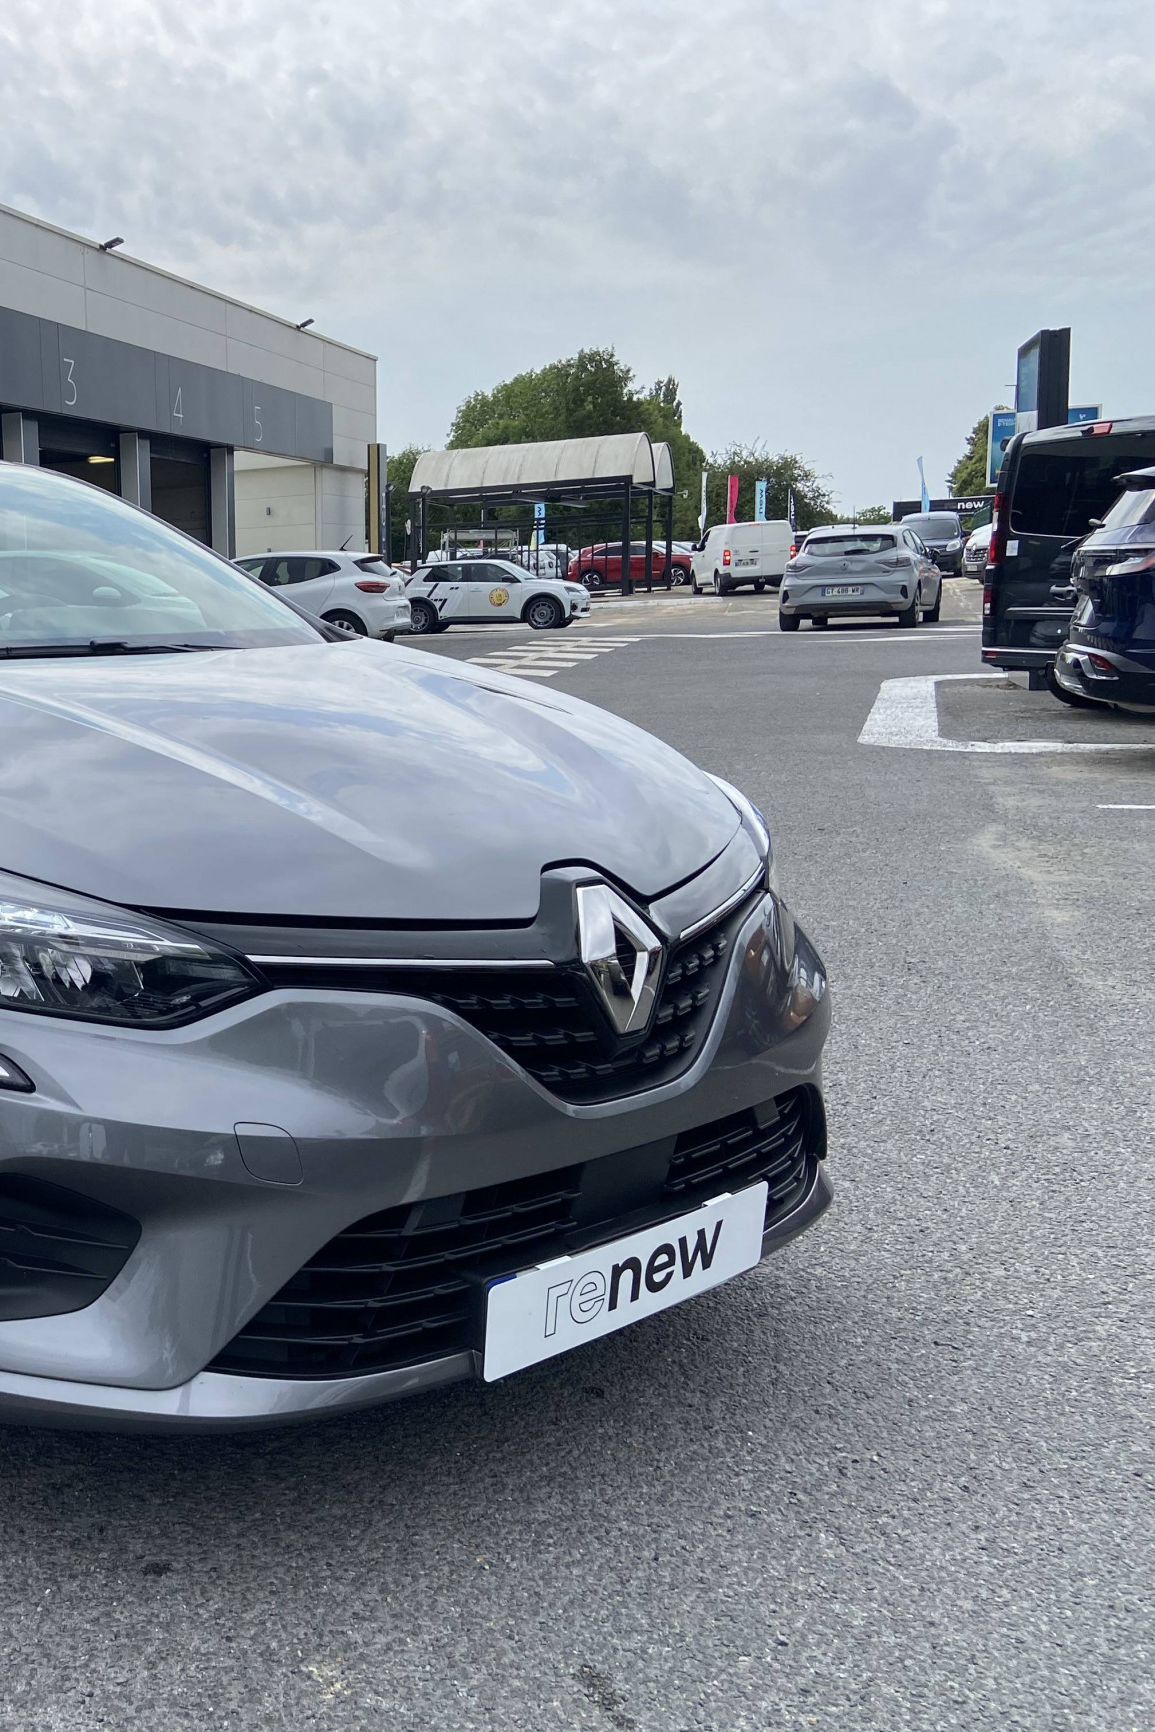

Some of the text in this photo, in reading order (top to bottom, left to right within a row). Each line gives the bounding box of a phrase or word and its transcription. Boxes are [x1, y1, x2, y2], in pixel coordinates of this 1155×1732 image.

[63, 358, 77, 405] 3
[173, 387, 184, 426] 4
[254, 406, 263, 442] 5
[544, 1219, 724, 1338] renew
